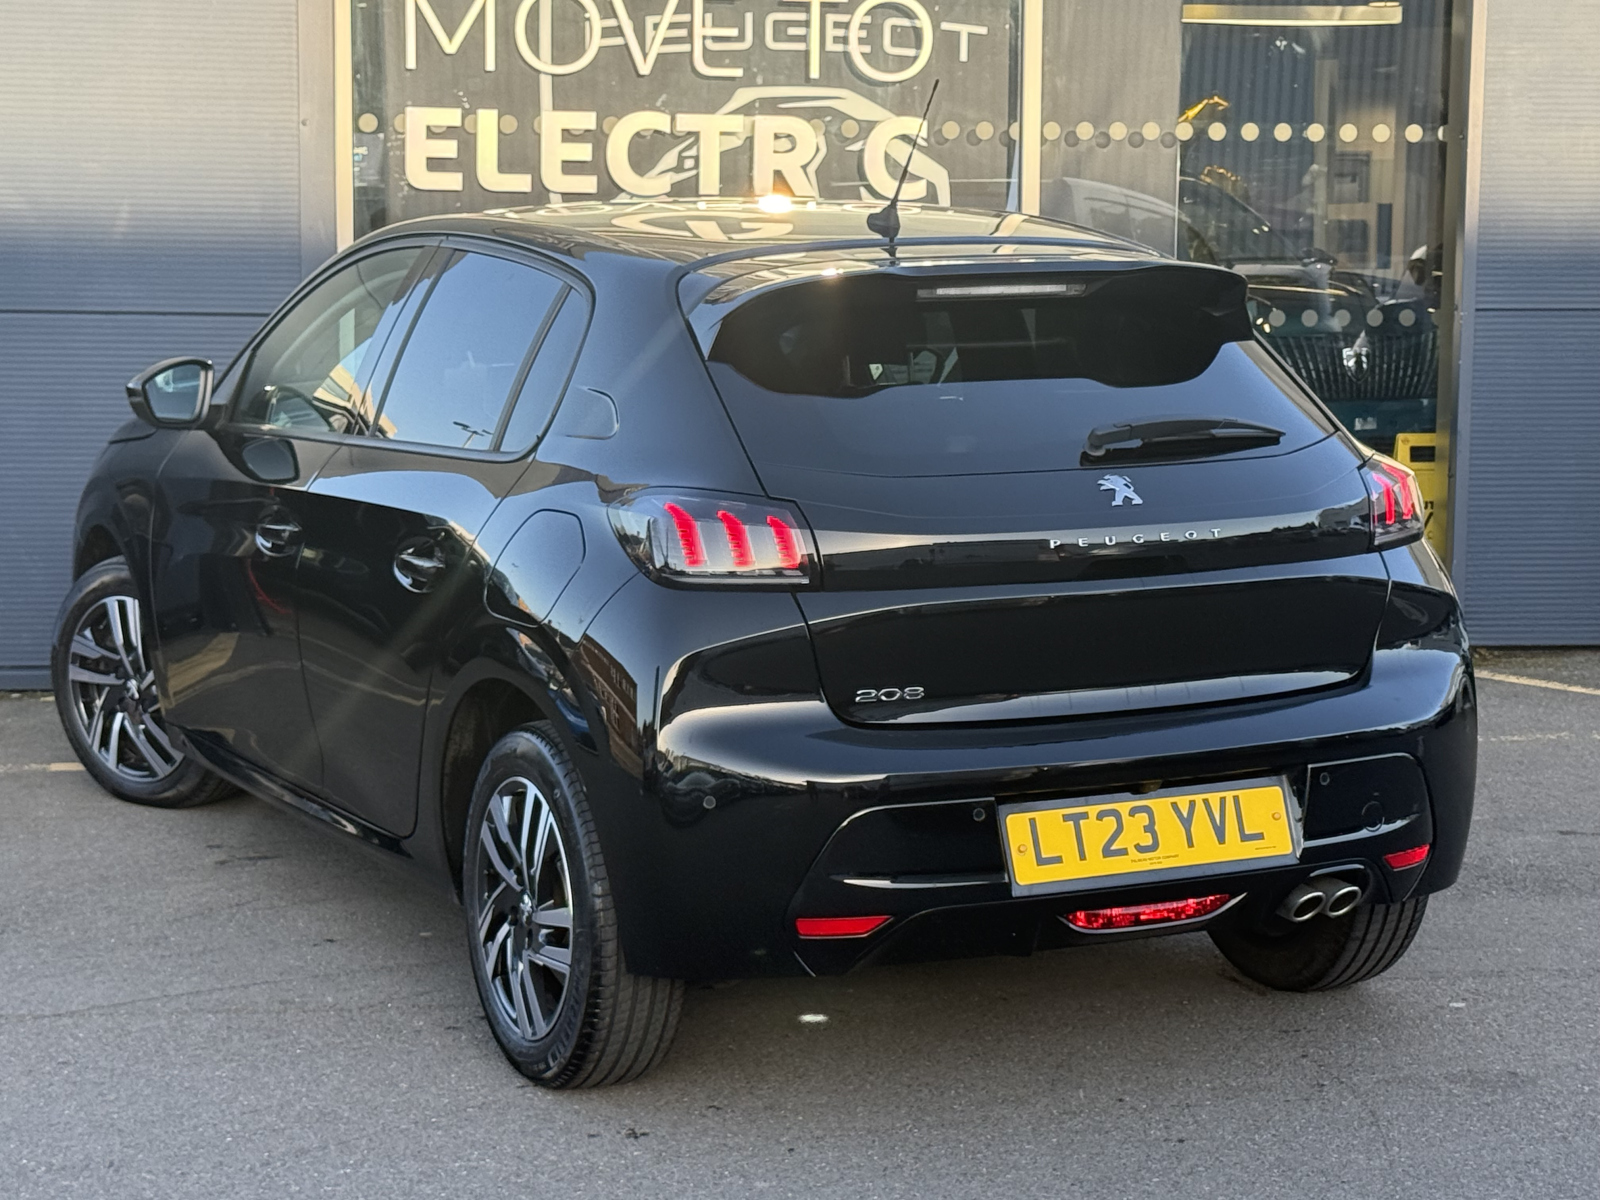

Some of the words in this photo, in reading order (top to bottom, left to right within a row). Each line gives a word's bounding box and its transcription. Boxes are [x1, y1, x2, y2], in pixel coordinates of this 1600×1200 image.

[404, 0, 744, 79] MOVE
[782, 0, 933, 83] TO
[1050, 528, 1221, 549] PEUGEOT
[855, 686, 925, 703] 208
[1028, 804, 1160, 867] LT23
[1170, 794, 1266, 849] YVL
